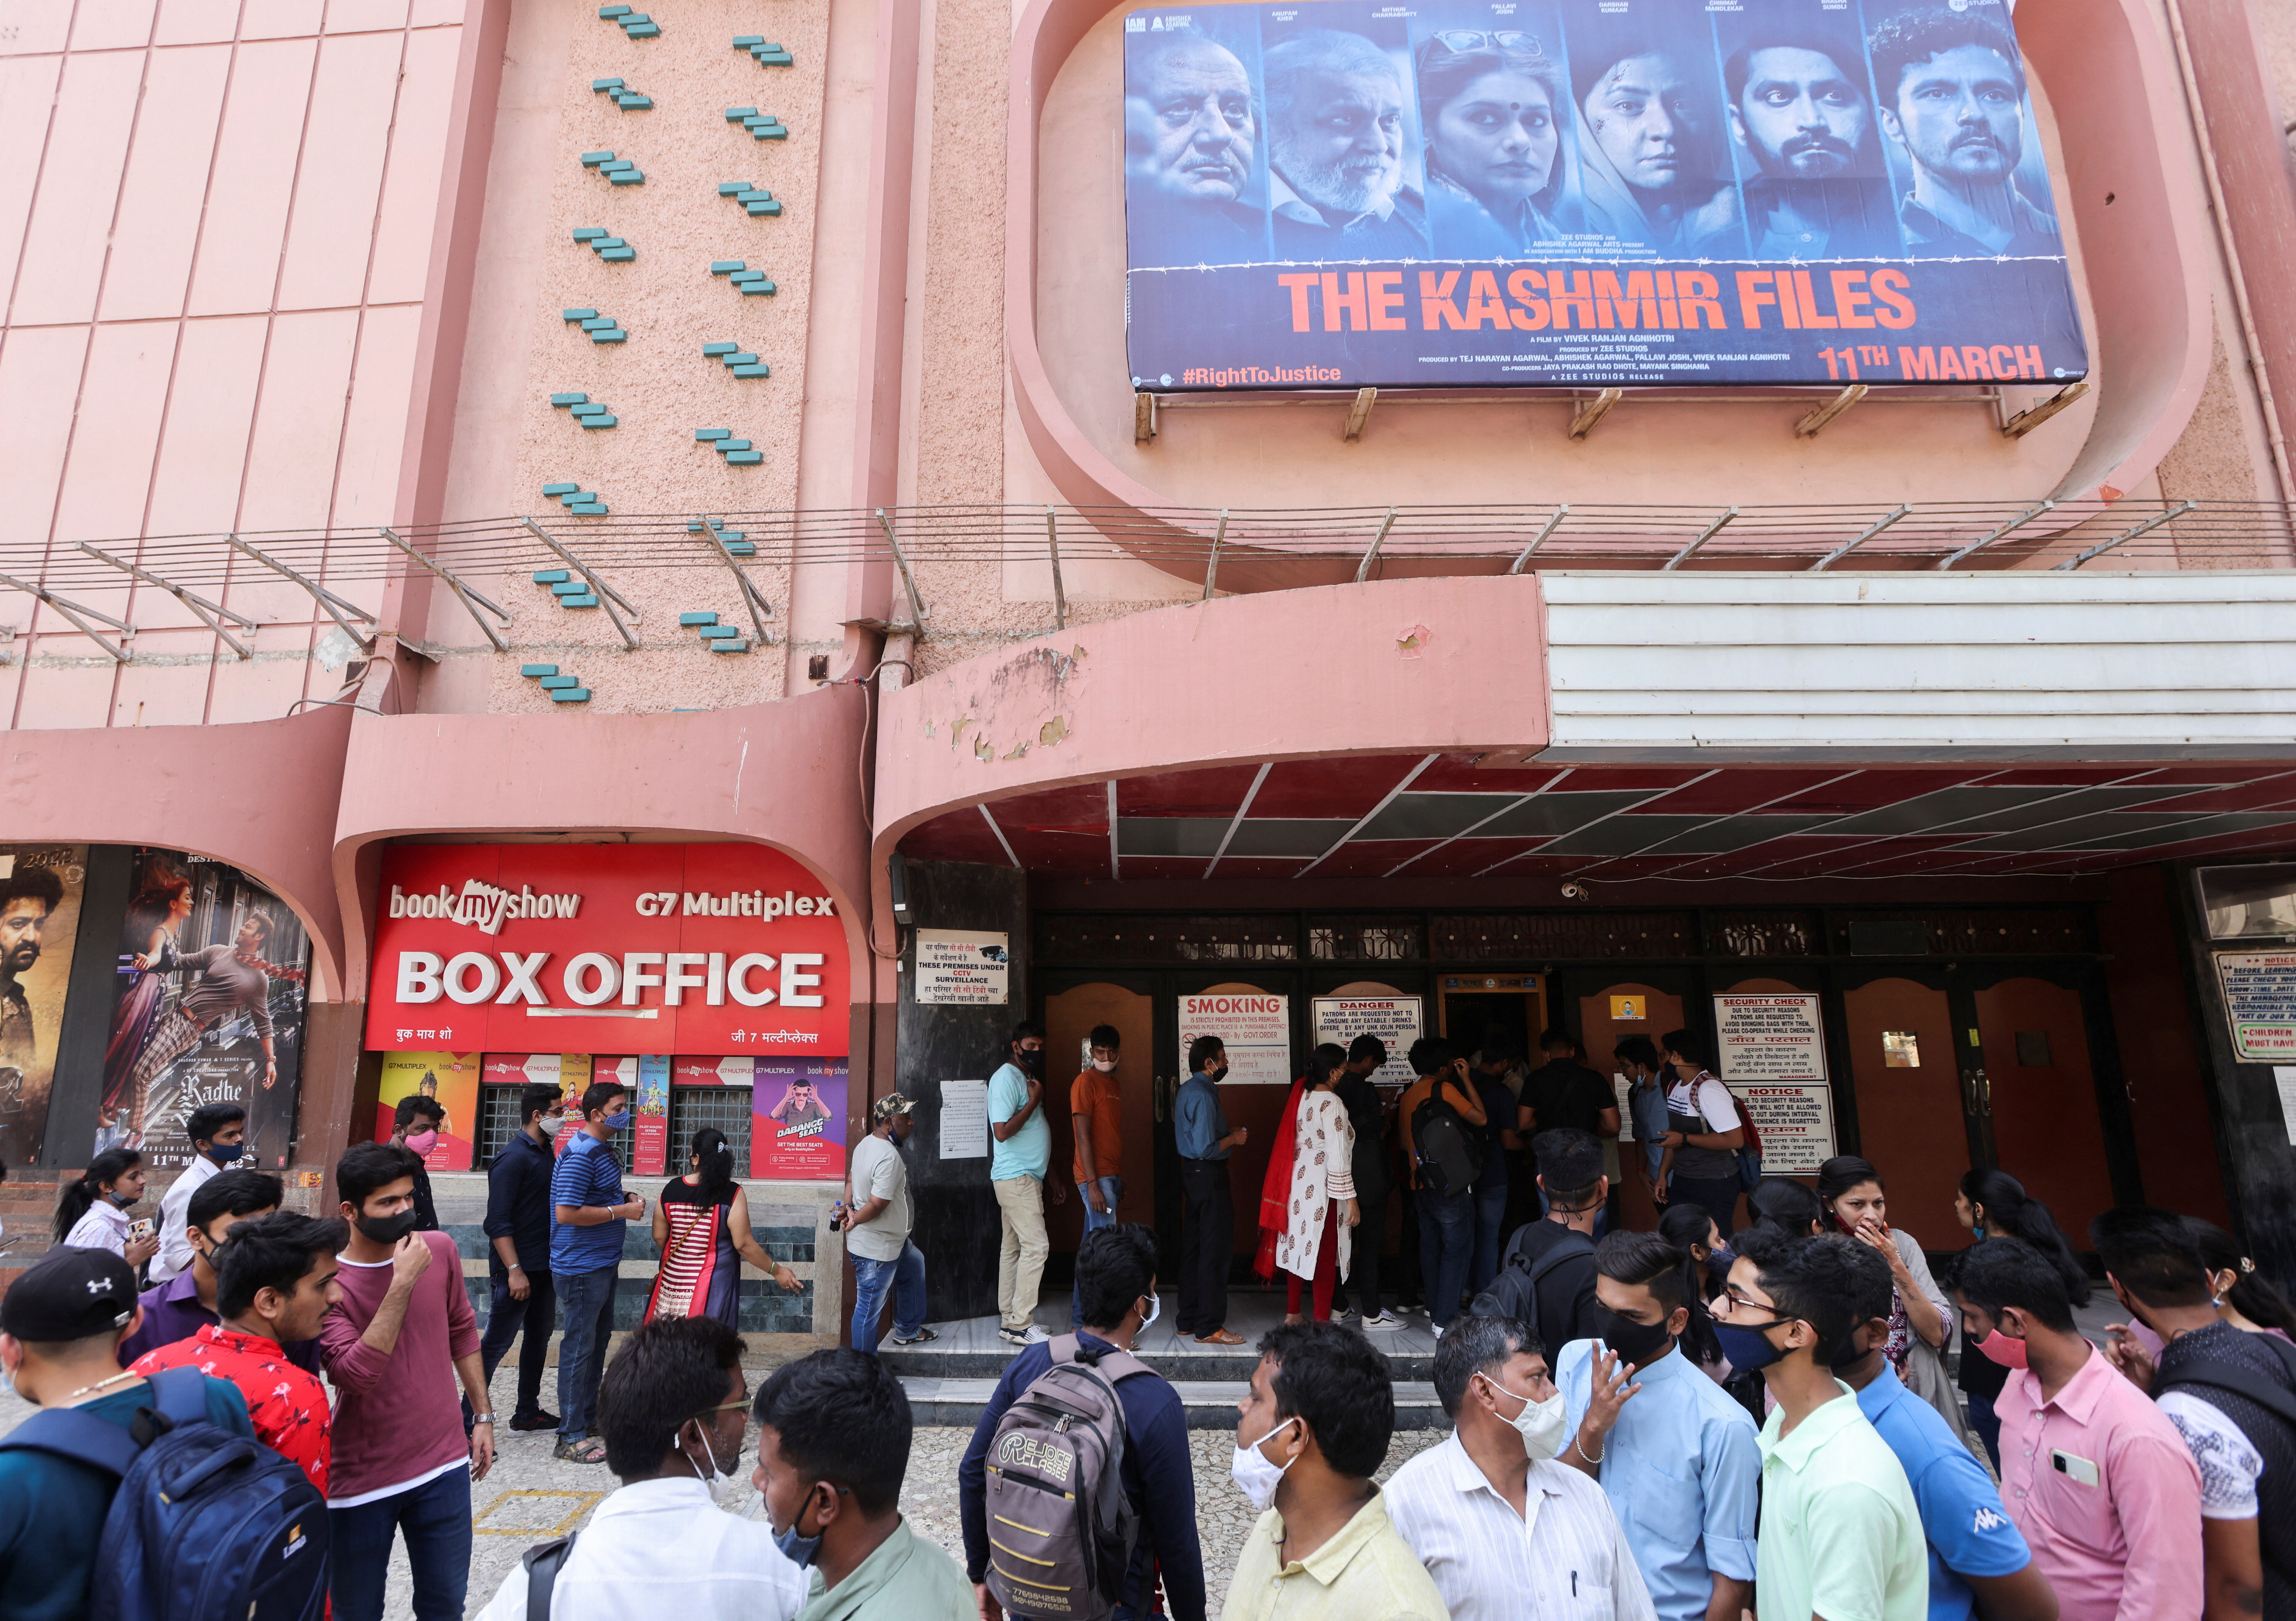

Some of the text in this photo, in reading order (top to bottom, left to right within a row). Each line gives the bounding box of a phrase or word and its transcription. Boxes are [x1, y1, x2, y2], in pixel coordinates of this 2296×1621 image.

[1278, 268, 1917, 332] THE KASHMIR FILES
[1513, 354, 1552, 363] AGARWAL,
[1594, 354, 1633, 362] AGARWAL,
[1818, 345, 2046, 380] 11TH MARCH
[1183, 365, 1341, 387] #RightToJustice
[635, 889, 834, 922] G7 Multiplex
[396, 951, 824, 1006] BOX OFFICE
[1187, 998, 1280, 1013] SMOKING
[396, 1026, 452, 1042] बुक माय शो
[731, 1029, 818, 1043] जी 7 मल्टीप्लेक्स
[181, 1074, 242, 1106] Radhe
[639, 1105, 665, 1115] OMG
[777, 1118, 824, 1138] DABANGG
[799, 1125, 823, 1138] SEATS
[152, 1155, 179, 1166] 11TH
[999, 1433, 1073, 1470] REJOICE
[1023, 1454, 1067, 1482] CLASSES
